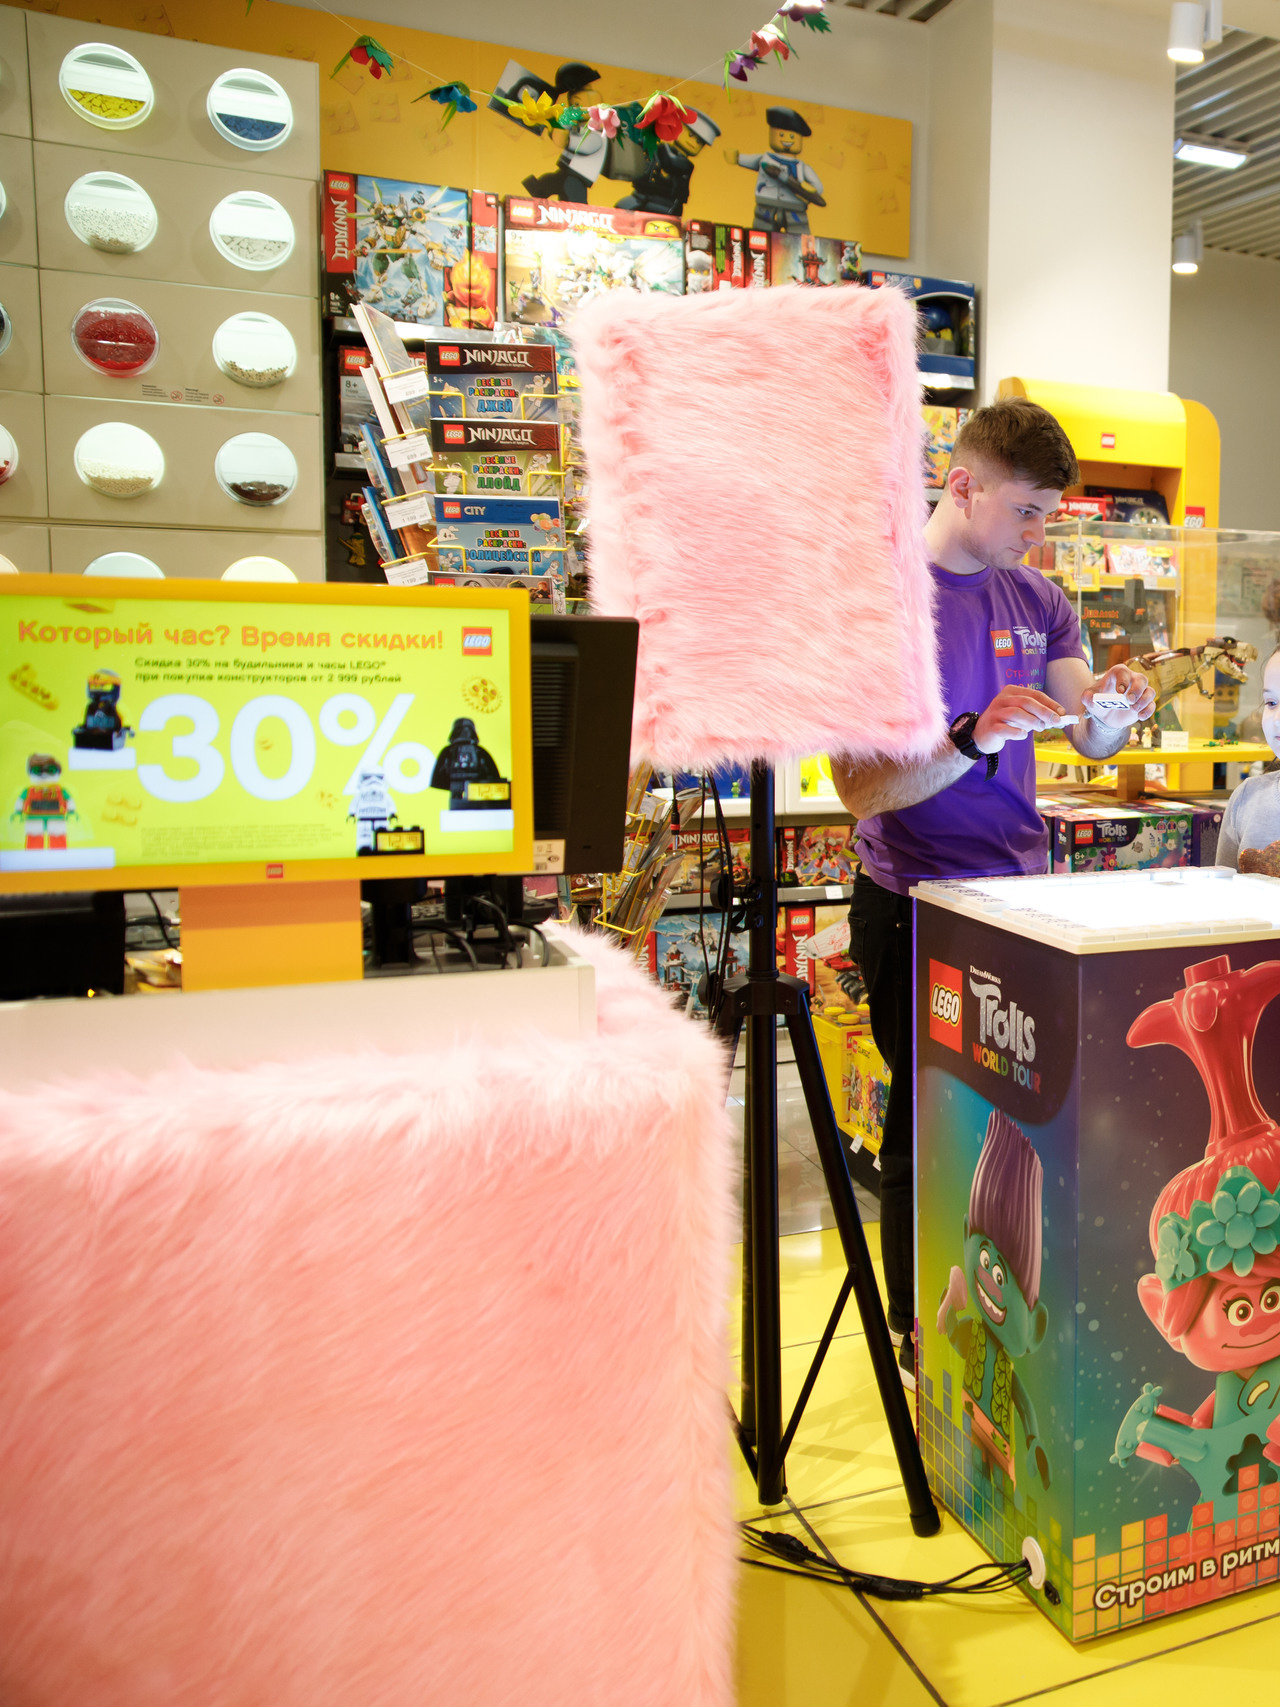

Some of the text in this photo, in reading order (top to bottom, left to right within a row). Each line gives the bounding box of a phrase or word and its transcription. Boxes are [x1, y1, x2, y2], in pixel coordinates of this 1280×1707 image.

[329, 179, 350, 190] LEGO
[536, 204, 618, 234] NINJAGO
[330, 196, 350, 260] NINJAGO
[441, 351, 459, 360] LEGO
[462, 348, 534, 368] NINJAGO
[345, 380, 358, 388] 8+
[468, 387, 519, 398] РАСКРАСКИ:
[477, 399, 514, 413] ДЖЕЙ
[445, 429, 464, 439] LEGO
[467, 427, 538, 446] NINJAGO
[473, 465, 523, 475] РАСКРАСКИ:
[477, 476, 521, 491] ЛЛОЙД
[444, 505, 487, 516] LEGO CITY
[477, 538, 527, 549] РАСКРАСКИ:
[1090, 619, 1111, 628] PARK
[18, 620, 443, 652] Который час? Время скидки!
[463, 634, 492, 648] LEGO
[995, 637, 1012, 649] LEGO
[1014, 629, 1047, 649] Trolls
[134, 657, 182, 668] Скидка
[186, 657, 211, 668] 30%
[214, 659, 230, 668] на
[233, 658, 303, 671] будильники
[317, 660, 346, 669] часы
[134, 672, 158, 683] при
[217, 673, 307, 684] конструкторов
[311, 674, 323, 682] от
[338, 673, 358, 683] 999
[361, 674, 402, 685] рублей
[137, 693, 437, 803] 30%
[1076, 823, 1128, 839] LEGO Trolls
[1074, 852, 1085, 860] 6+
[791, 915, 810, 925] LEGO
[931, 983, 962, 1026] LEGO
[969, 976, 1036, 1063] Trolls
[972, 1041, 1041, 1094] WORLD TOUR
[1095, 1567, 1195, 1609] Строим
[1202, 1558, 1217, 1577] в
